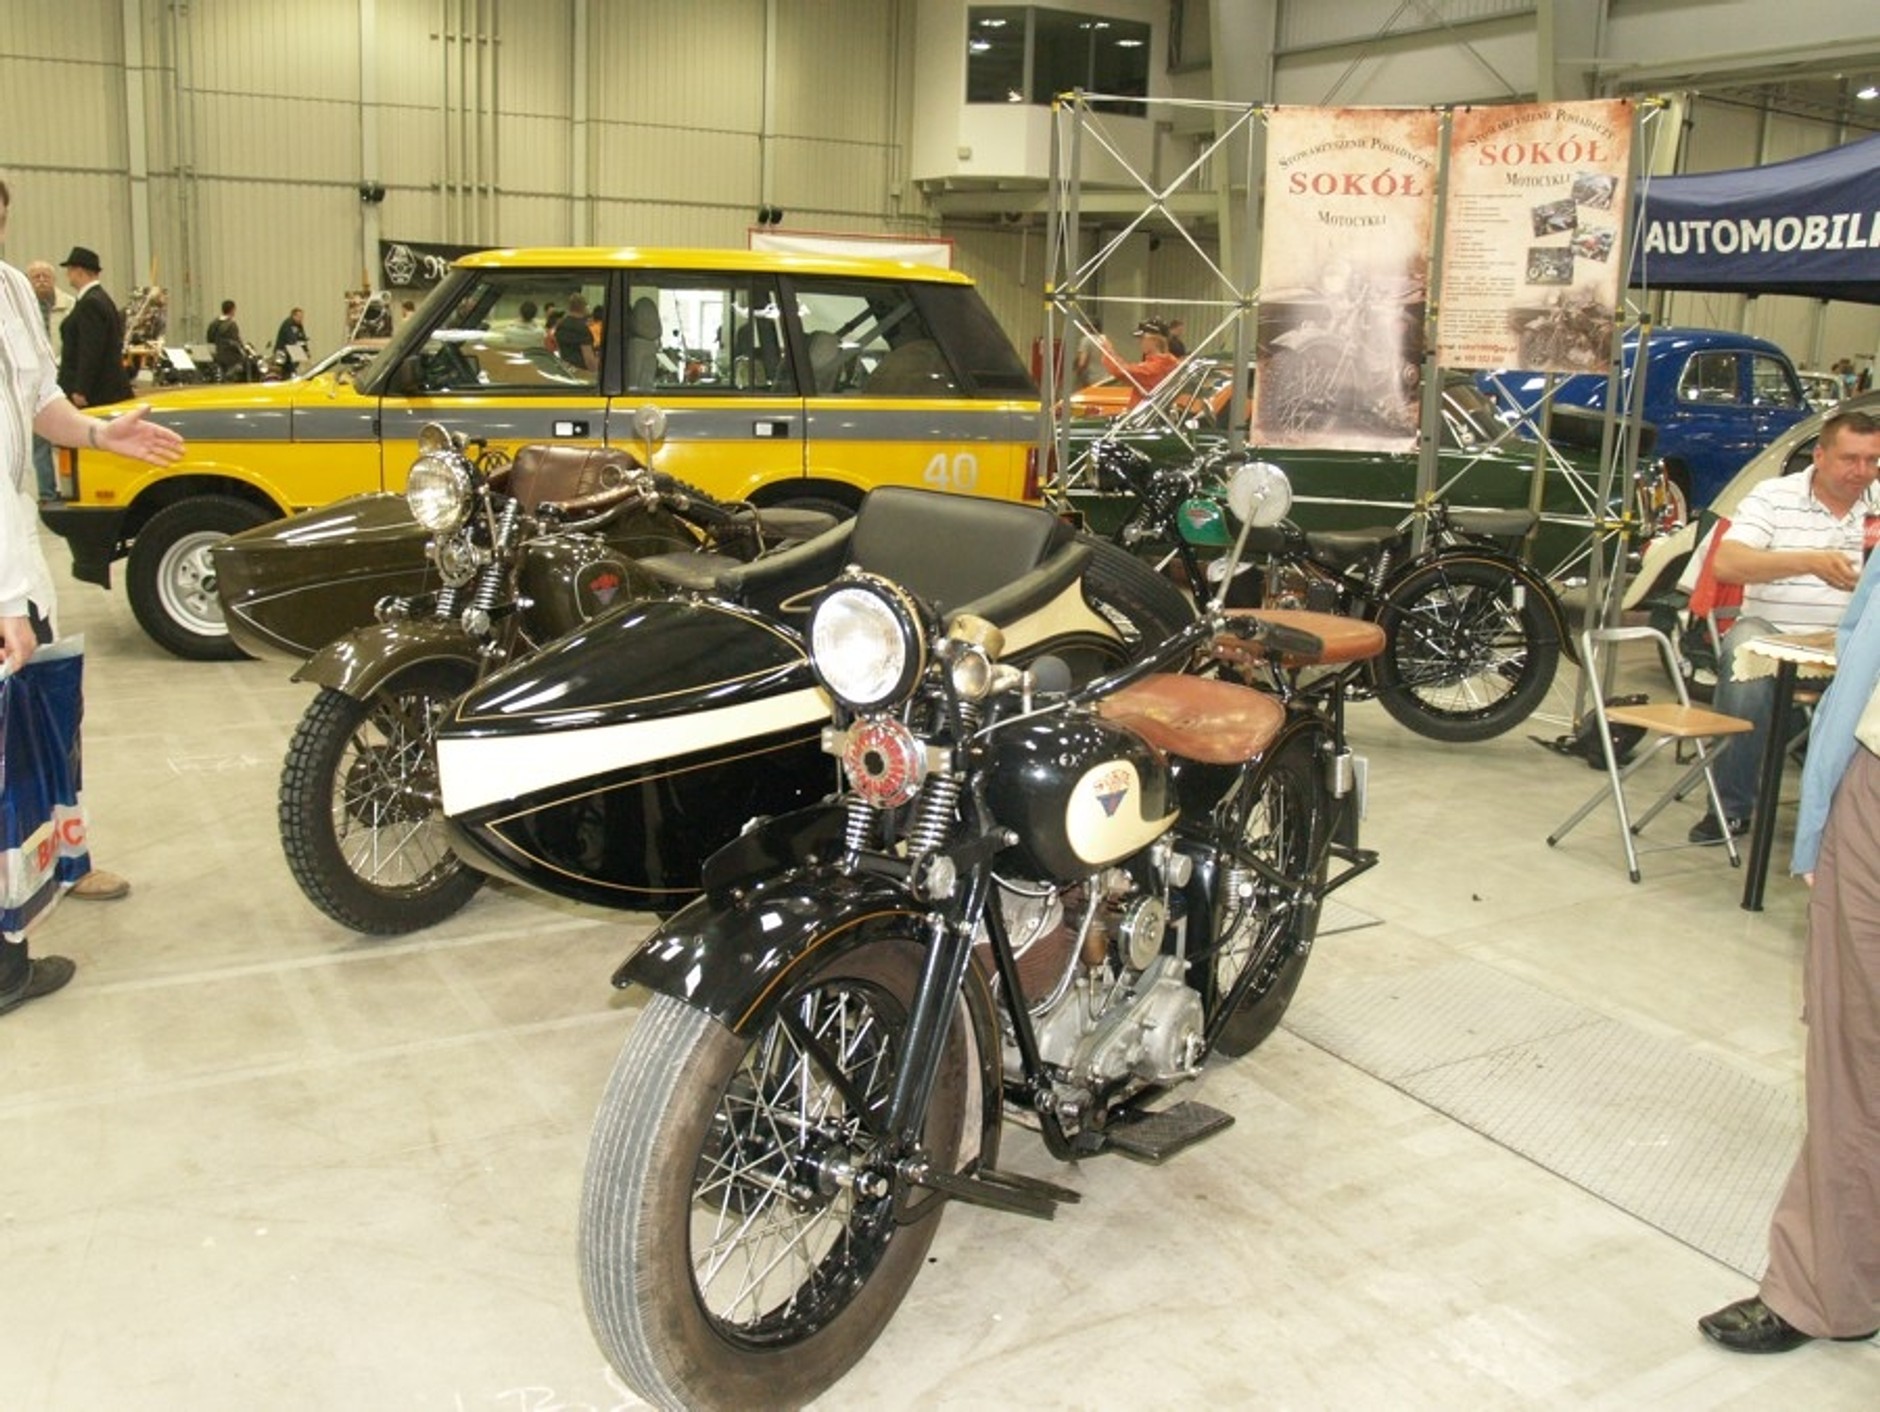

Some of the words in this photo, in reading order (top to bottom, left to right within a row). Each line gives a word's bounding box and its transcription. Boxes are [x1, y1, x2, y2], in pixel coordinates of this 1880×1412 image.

[1478, 134, 1608, 167] SOKÓŁ
[1288, 167, 1424, 198] SOKÓŁ
[922, 452, 978, 492] 40
